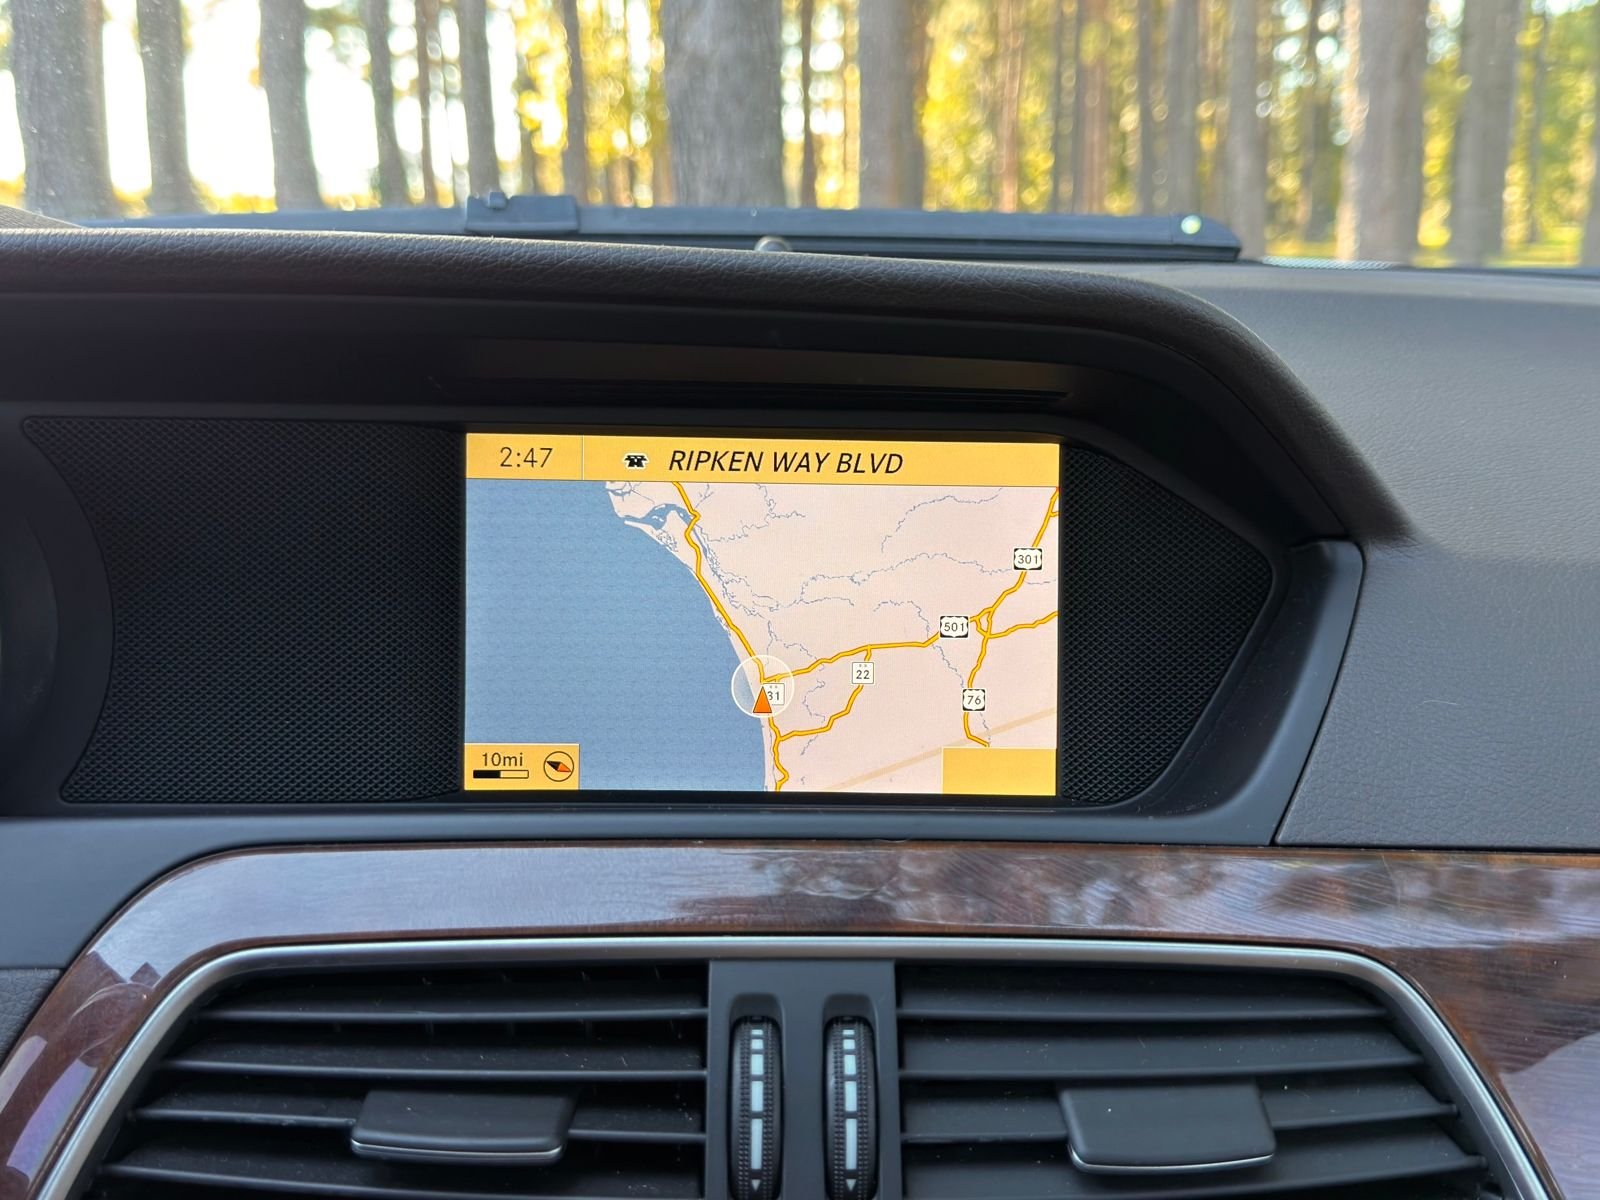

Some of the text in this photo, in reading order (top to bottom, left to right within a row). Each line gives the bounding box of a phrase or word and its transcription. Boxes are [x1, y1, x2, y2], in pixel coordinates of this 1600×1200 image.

[499, 446, 554, 468] 2:47
[668, 449, 904, 474] RIPKEN WAY BLVD
[1017, 554, 1038, 565] 301
[943, 622, 965, 632] 501
[855, 669, 870, 680] 22
[767, 690, 780, 701] 31
[966, 695, 982, 705] 76
[482, 752, 523, 767] 10mi
